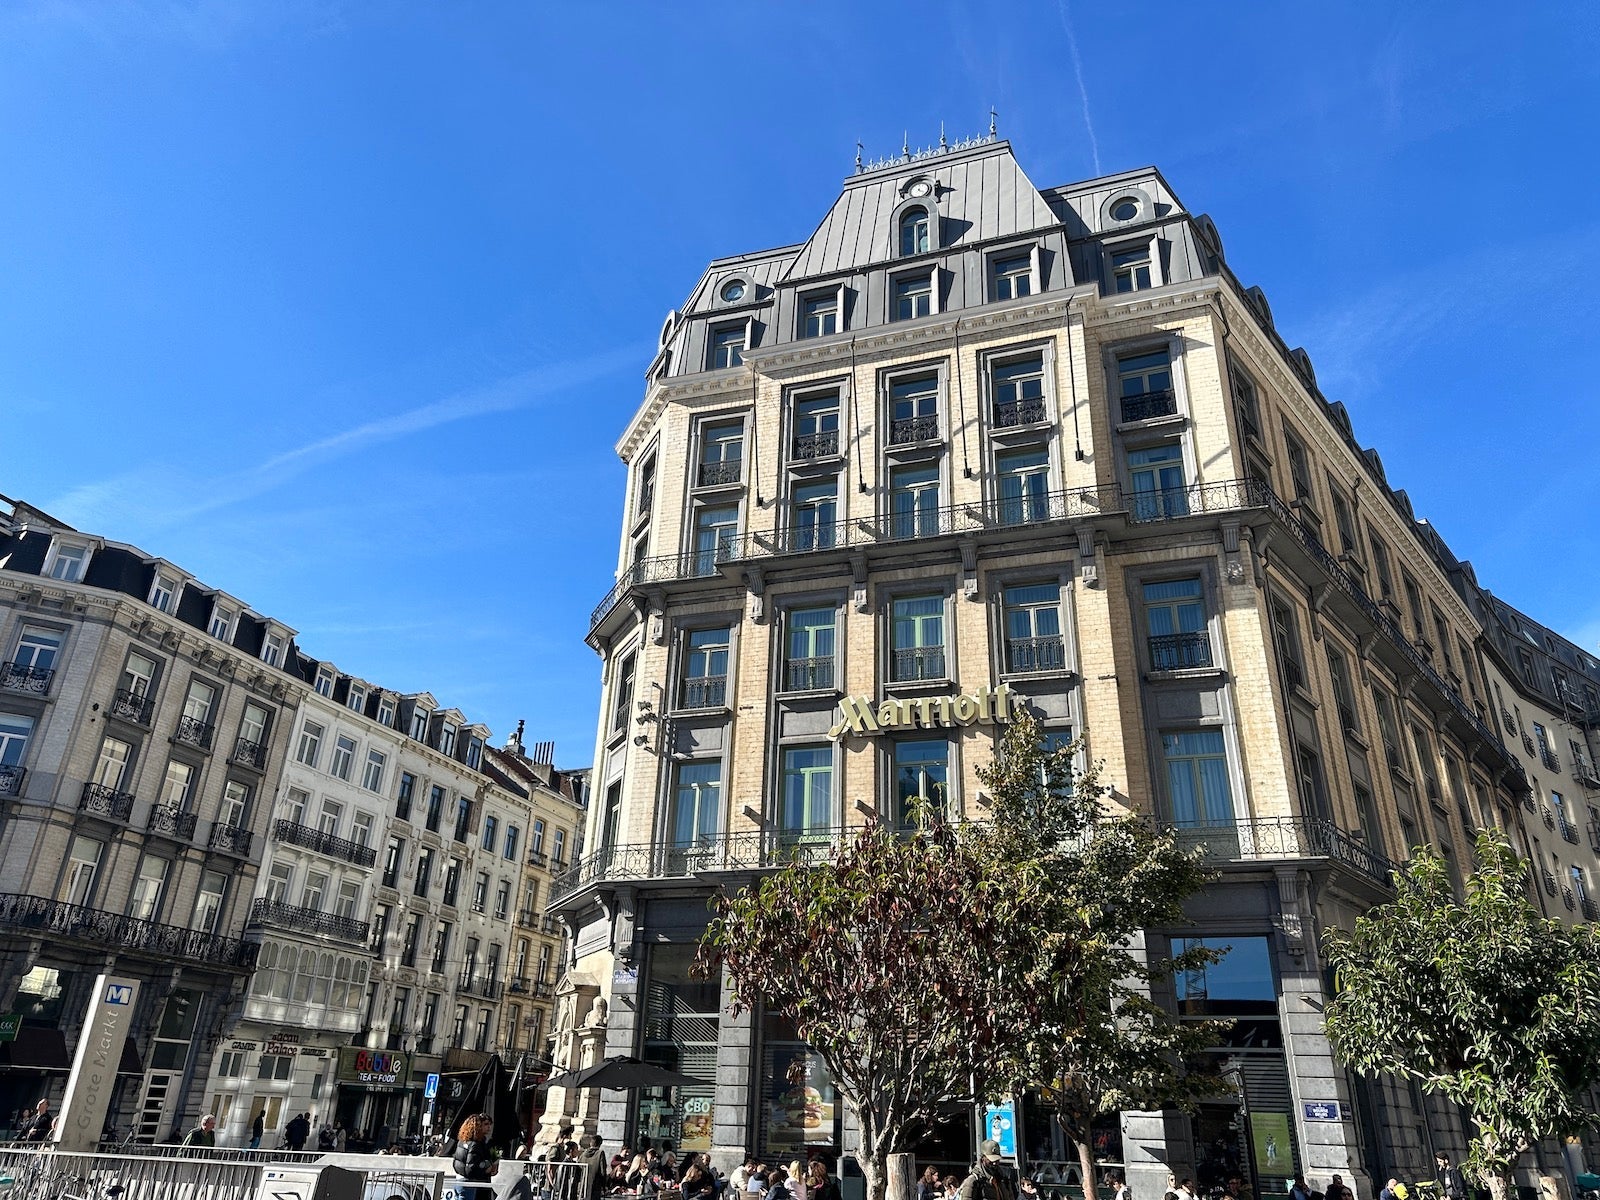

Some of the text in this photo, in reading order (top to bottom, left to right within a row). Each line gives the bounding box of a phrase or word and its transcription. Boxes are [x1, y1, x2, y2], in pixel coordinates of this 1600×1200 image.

[826, 683, 1009, 741] Marriott
[105, 985, 132, 1005] M
[77, 1074, 102, 1129] Grote
[93, 1009, 118, 1068] Markt
[356, 1051, 401, 1073] Bubble
[684, 1101, 710, 1113] CBO
